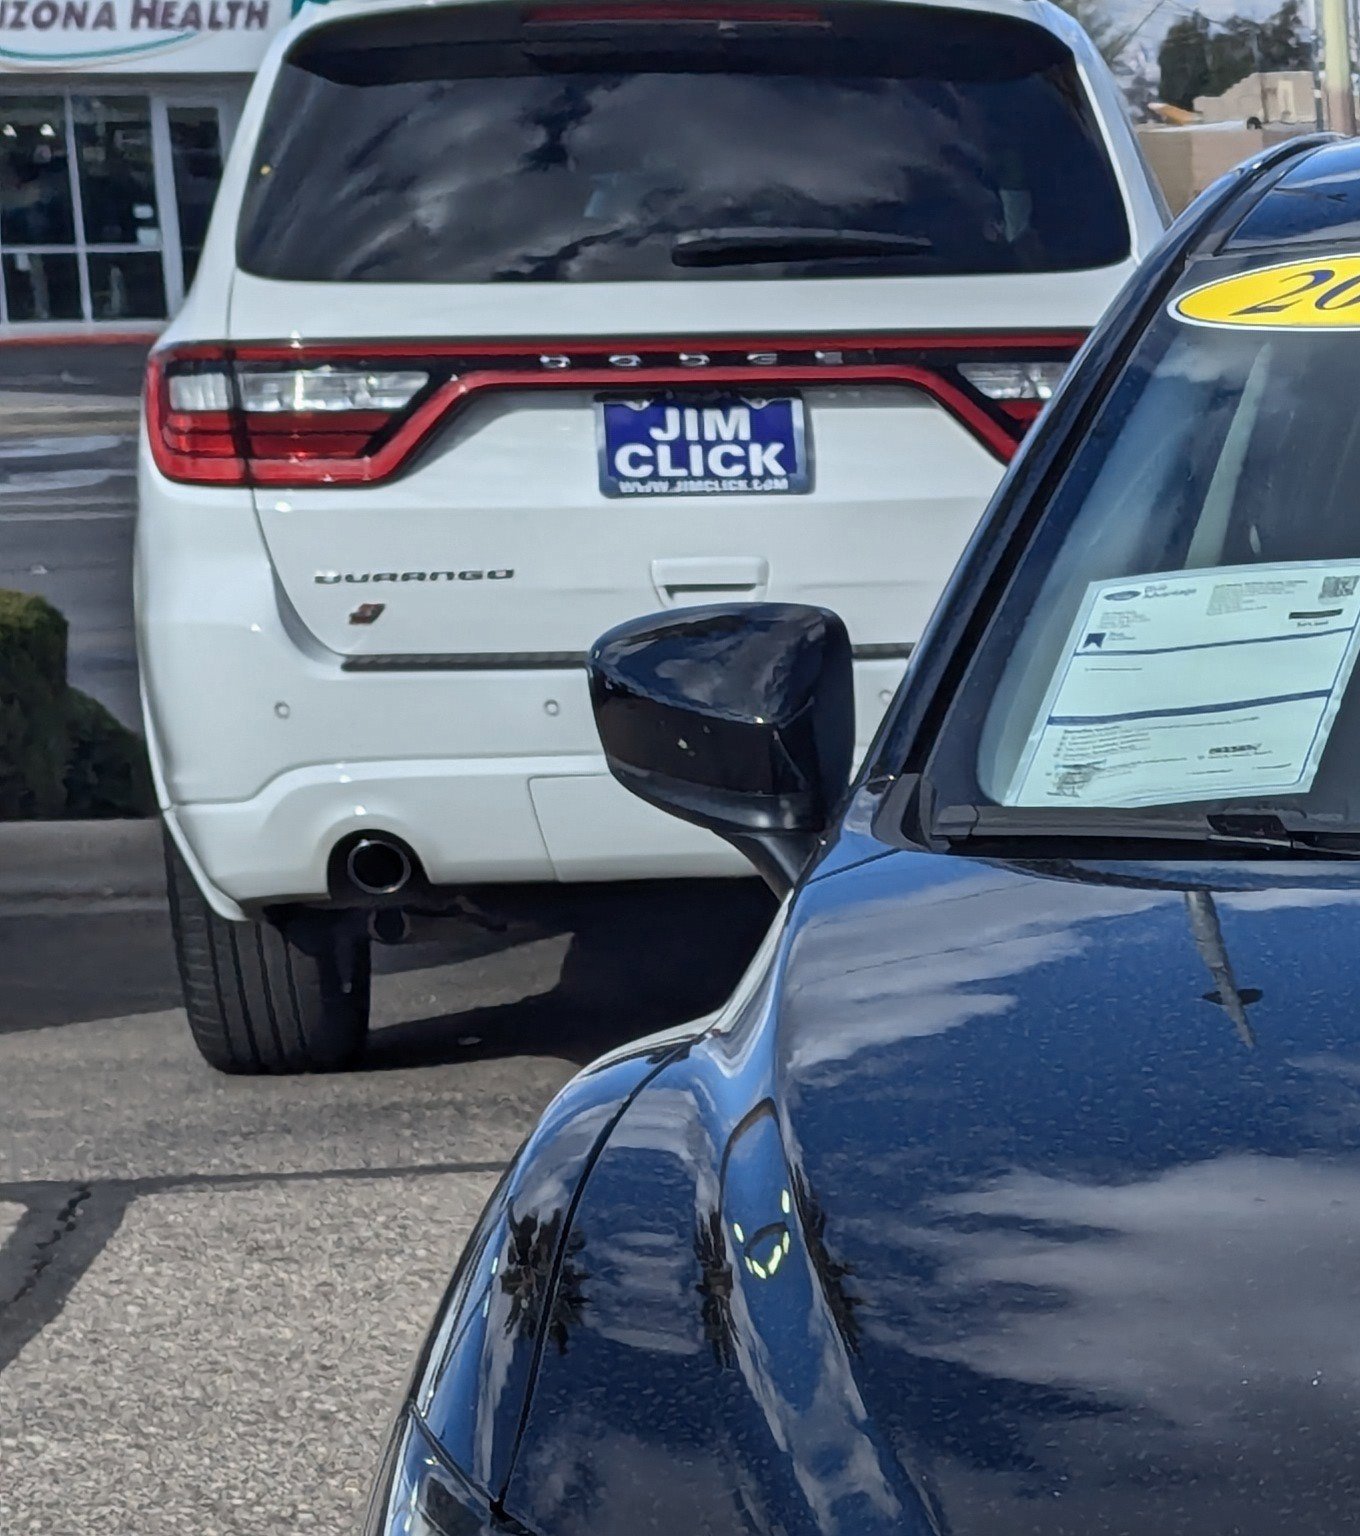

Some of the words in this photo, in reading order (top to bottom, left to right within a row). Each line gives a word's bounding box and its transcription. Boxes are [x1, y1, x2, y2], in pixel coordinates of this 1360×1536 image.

[130, 0, 269, 31] HEALTH
[650, 406, 752, 441] JIM
[614, 443, 787, 477] CLICK
[314, 569, 514, 584] DURANGO
